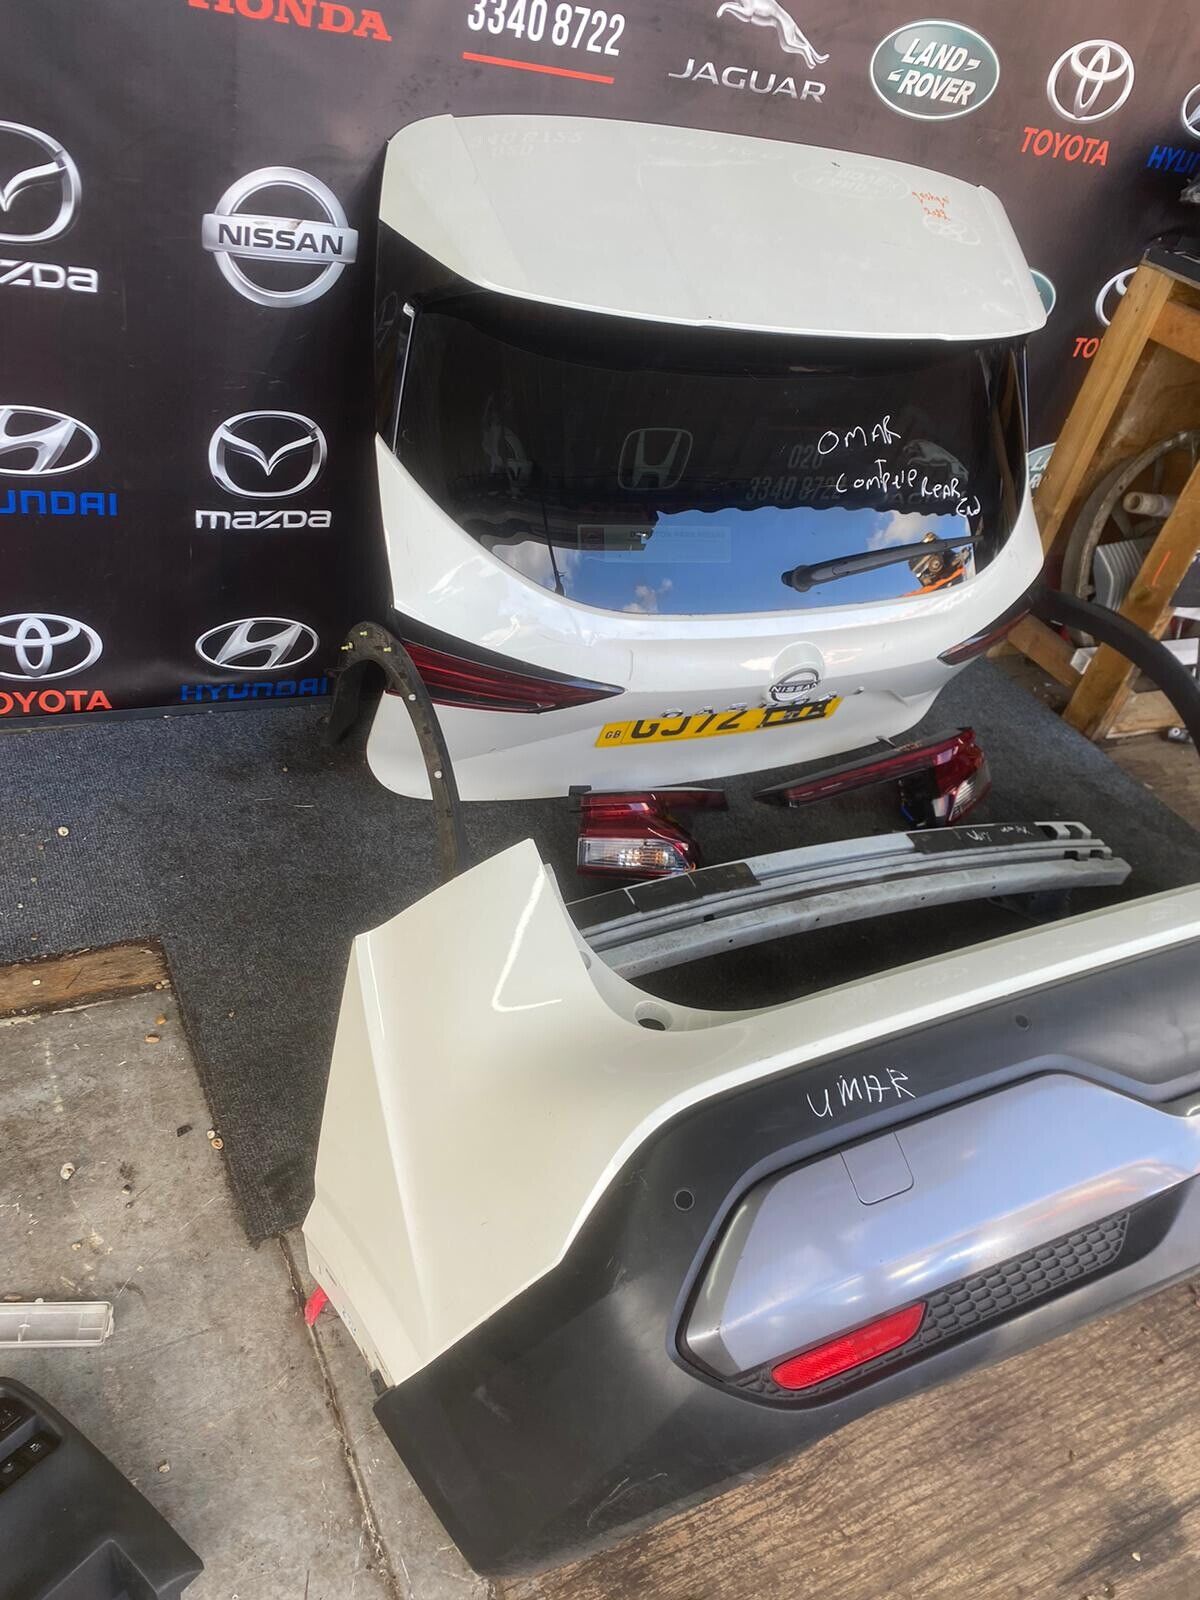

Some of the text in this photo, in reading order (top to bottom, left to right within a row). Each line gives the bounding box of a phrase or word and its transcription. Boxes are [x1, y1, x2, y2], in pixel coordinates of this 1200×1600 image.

[467, 0, 625, 56] 3340 8722
[900, 37, 970, 73] LAND
[668, 57, 826, 103] JAGUAR
[898, 69, 977, 106] ROVER
[1021, 126, 1110, 167] TOYOTA
[218, 224, 344, 256] NISSAN
[817, 415, 902, 455] OMAR
[180, 676, 329, 702] HYUNDAI
[769, 681, 821, 695] NISSAN
[604, 729, 621, 740] GB
